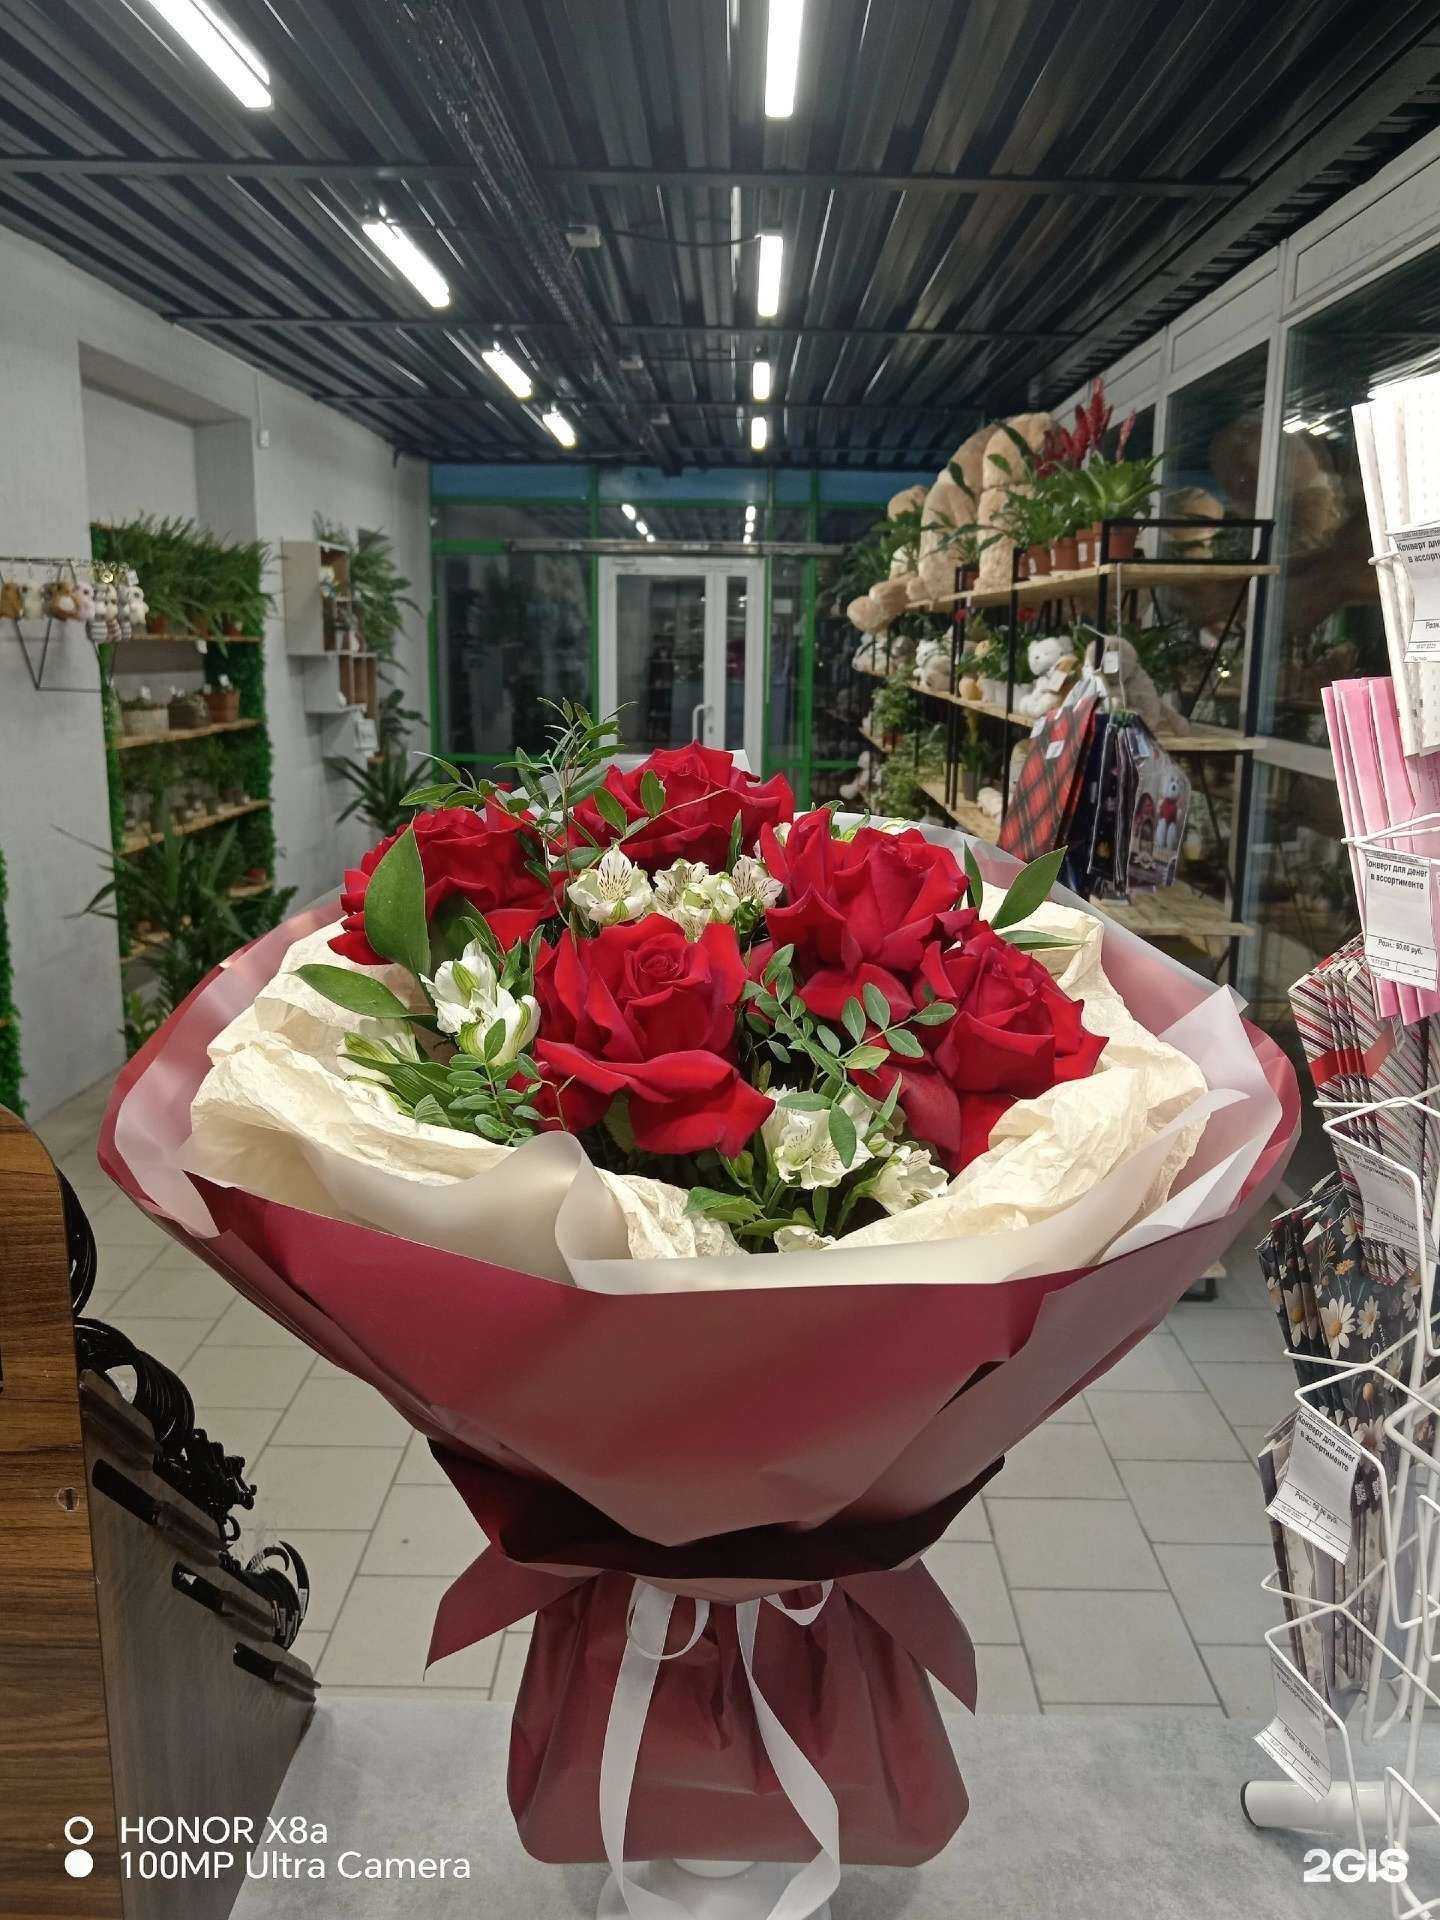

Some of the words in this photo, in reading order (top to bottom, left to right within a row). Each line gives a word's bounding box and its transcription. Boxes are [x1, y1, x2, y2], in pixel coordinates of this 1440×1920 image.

[1397, 541, 1426, 551] Конверт
[1392, 865, 1406, 874] для
[1407, 868, 1428, 878] денег
[1376, 874, 1425, 890] ассортименте
[1298, 1414, 1323, 1438] Конверт
[1323, 1435, 1336, 1448] для
[1336, 1445, 1356, 1463] денег
[1305, 1435, 1349, 1472] ассортименте
